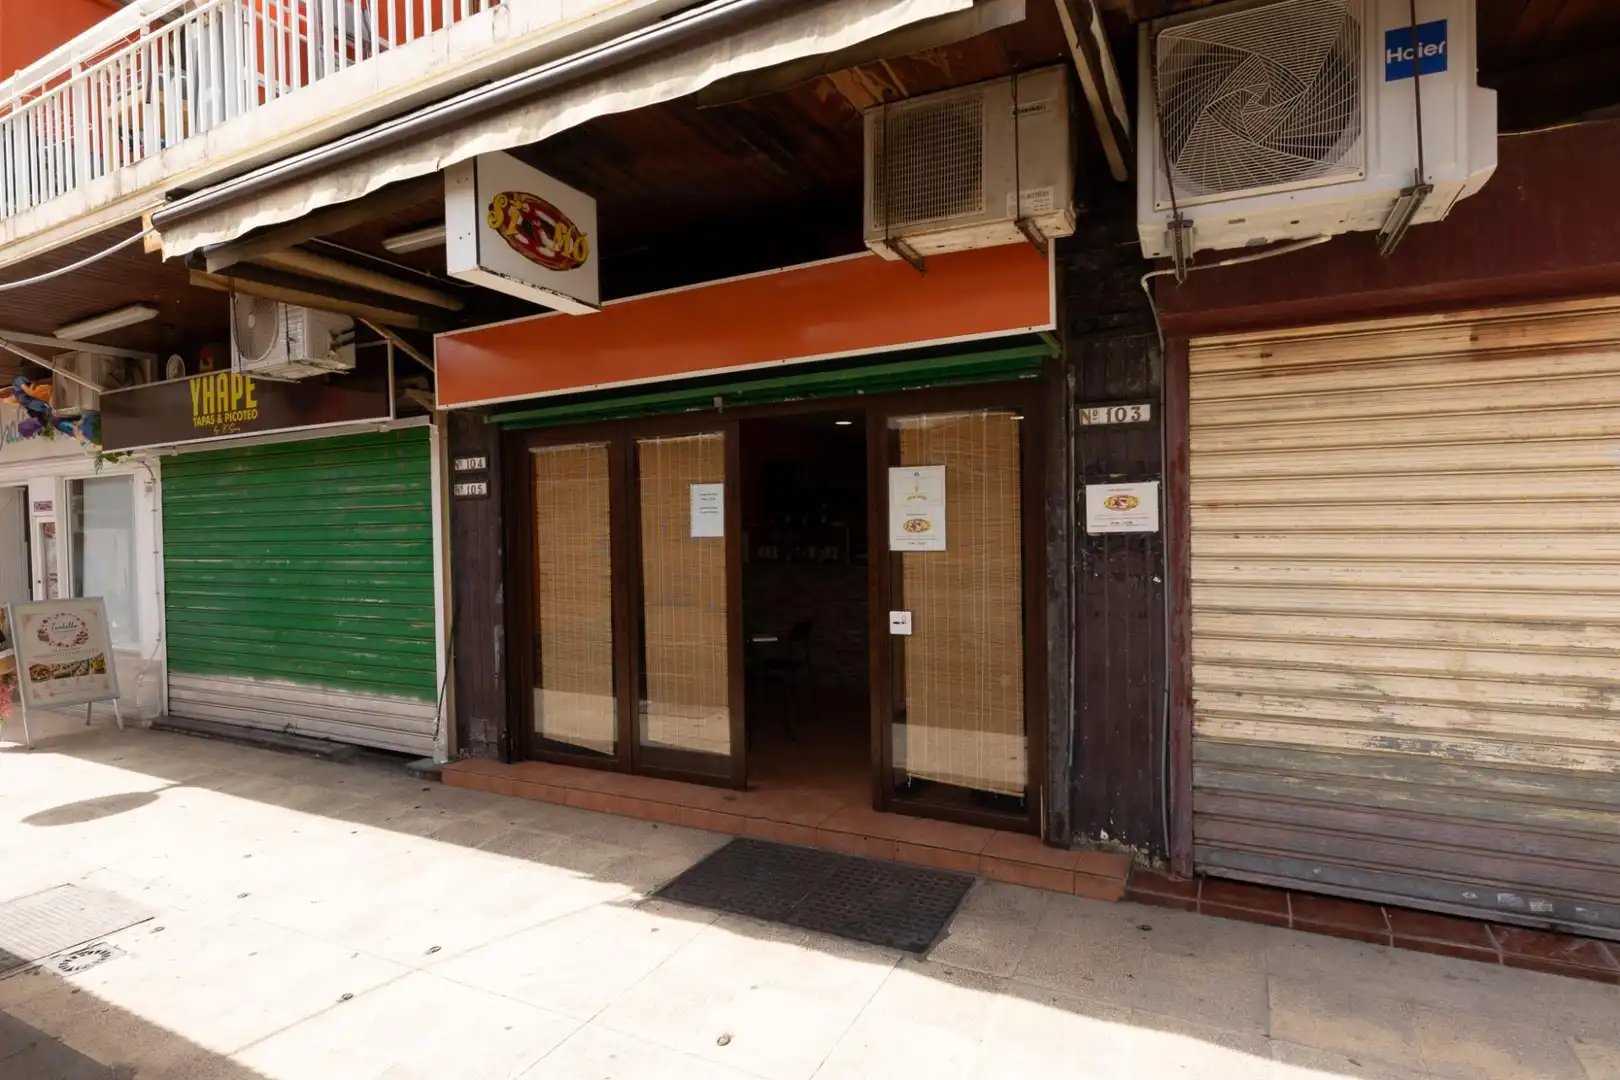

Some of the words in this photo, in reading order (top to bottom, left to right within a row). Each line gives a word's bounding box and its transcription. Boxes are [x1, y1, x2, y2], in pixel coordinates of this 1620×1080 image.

[1386, 41, 1446, 64] Haier
[190, 373, 257, 416] YHAPE
[193, 414, 215, 427] TAPAS
[225, 408, 258, 422] PICOTEO
[1107, 406, 1141, 423] 103
[467, 458, 483, 469] 104
[467, 484, 483, 496] 105
